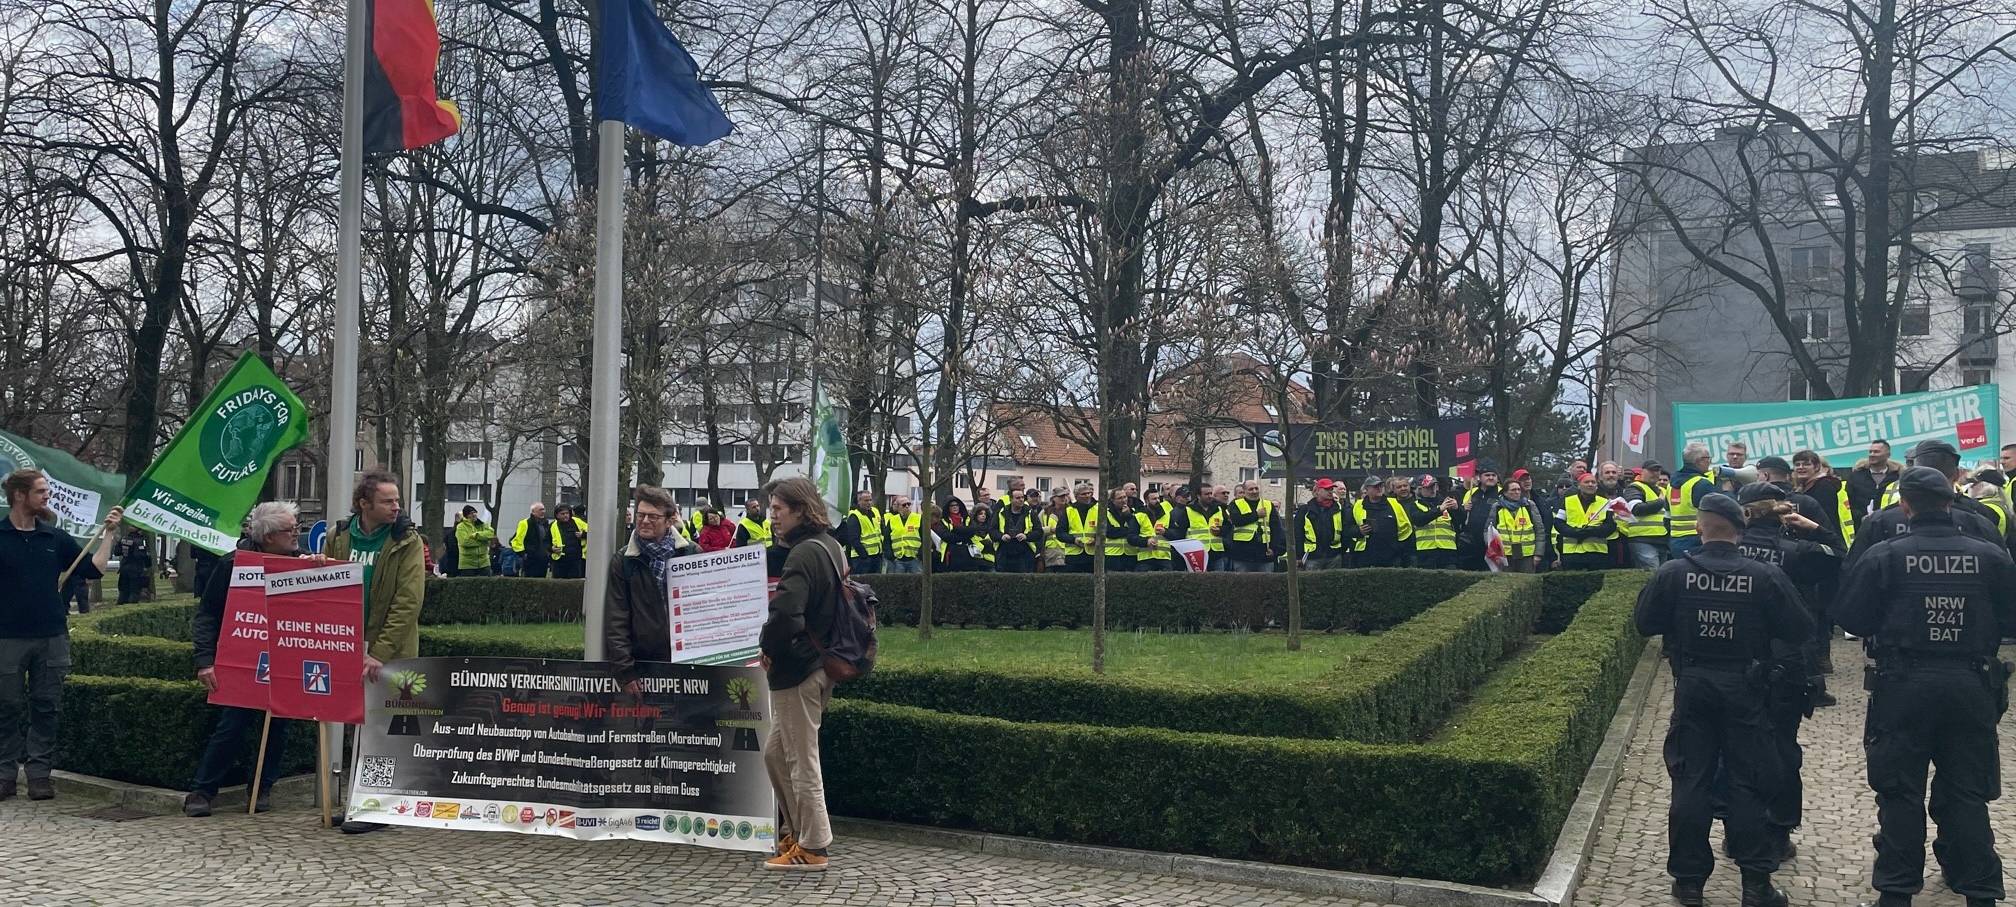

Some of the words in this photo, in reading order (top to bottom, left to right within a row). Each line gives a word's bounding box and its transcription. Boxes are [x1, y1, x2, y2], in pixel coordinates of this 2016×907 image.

[217, 388, 276, 419] FRIDAYS
[273, 401, 289, 427] FOR
[1315, 431, 1349, 449] INS
[1353, 428, 1438, 449] PERSONAL
[1687, 422, 1826, 464] USAMMEN
[1831, 408, 1902, 447] GEHT
[1911, 393, 1982, 433] MEHR
[1315, 450, 1440, 470] INVESTIEREN
[211, 459, 258, 482] FUTURE
[151, 488, 175, 507] Wir
[132, 503, 150, 519] bis
[152, 512, 168, 527] Ihr
[169, 520, 220, 546] handelt!
[671, 559, 709, 573] GROBES
[711, 551, 760, 567] FOULSPIEL!
[1905, 555, 1980, 574] POLIZEI
[239, 572, 264, 581] ROTE
[271, 578, 294, 588] ROTE
[295, 571, 351, 586] KLIMAKARTE
[1686, 573, 1753, 594] POLIZEI
[1925, 596, 1965, 610] NRW
[1698, 609, 1736, 625] NRW
[1927, 610, 1964, 626] 2641
[276, 620, 311, 633] KEINE
[314, 622, 355, 637] NEUEN
[1699, 624, 1734, 640] 2641
[1929, 627, 1962, 642] BAT
[277, 637, 355, 653] AUTOBAHNEN
[451, 670, 507, 688] BÜNDNIS
[510, 673, 621, 693] VERKEHRSINITIATIVEN
[683, 679, 709, 694] NRW
[502, 697, 536, 717] Genug
[538, 701, 551, 714] ist
[583, 702, 608, 719] Wir
[432, 721, 456, 735] Aus-
[457, 722, 476, 736] und
[477, 722, 532, 740] Neubaustopp
[533, 729, 547, 739] von
[548, 726, 586, 743] Autobahnen
[587, 730, 606, 744] und
[608, 730, 667, 744] Fernstraßen
[668, 731, 722, 748] (Moratorium)
[476, 748, 493, 761] des
[494, 748, 520, 762] BVWP
[521, 750, 537, 763] und
[538, 750, 642, 771] Bundesfernstraßengesetz
[644, 756, 659, 769] auf
[661, 756, 737, 775] Klimagerechtigkeit
[451, 770, 535, 789] Zukunftsgerechtes
[634, 784, 651, 794] aus
[653, 782, 679, 796] einem
[680, 782, 700, 797] Guss
